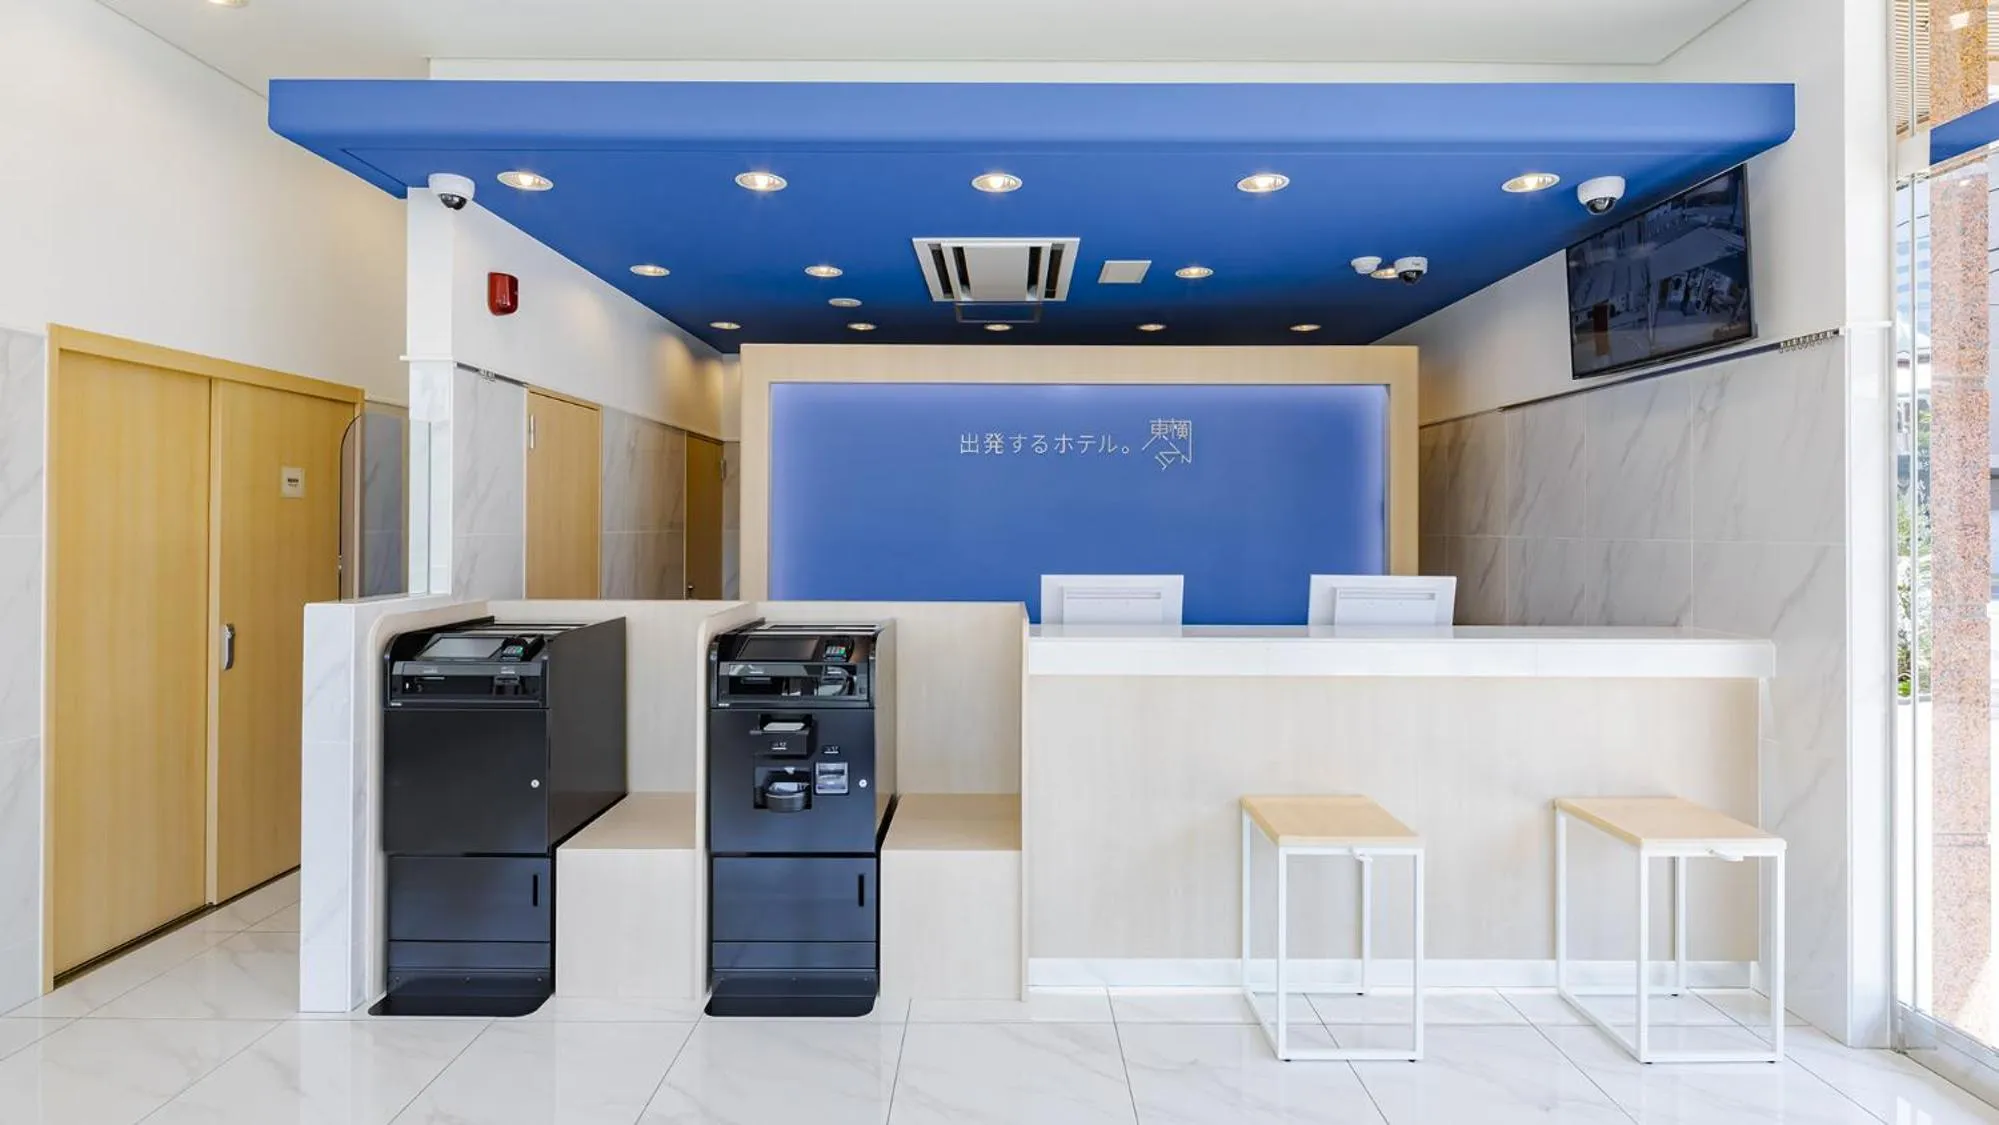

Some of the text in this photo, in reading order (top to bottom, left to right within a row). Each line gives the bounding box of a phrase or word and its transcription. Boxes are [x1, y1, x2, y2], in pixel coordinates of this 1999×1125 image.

[960, 433, 1130, 454] 出発するホテル。
